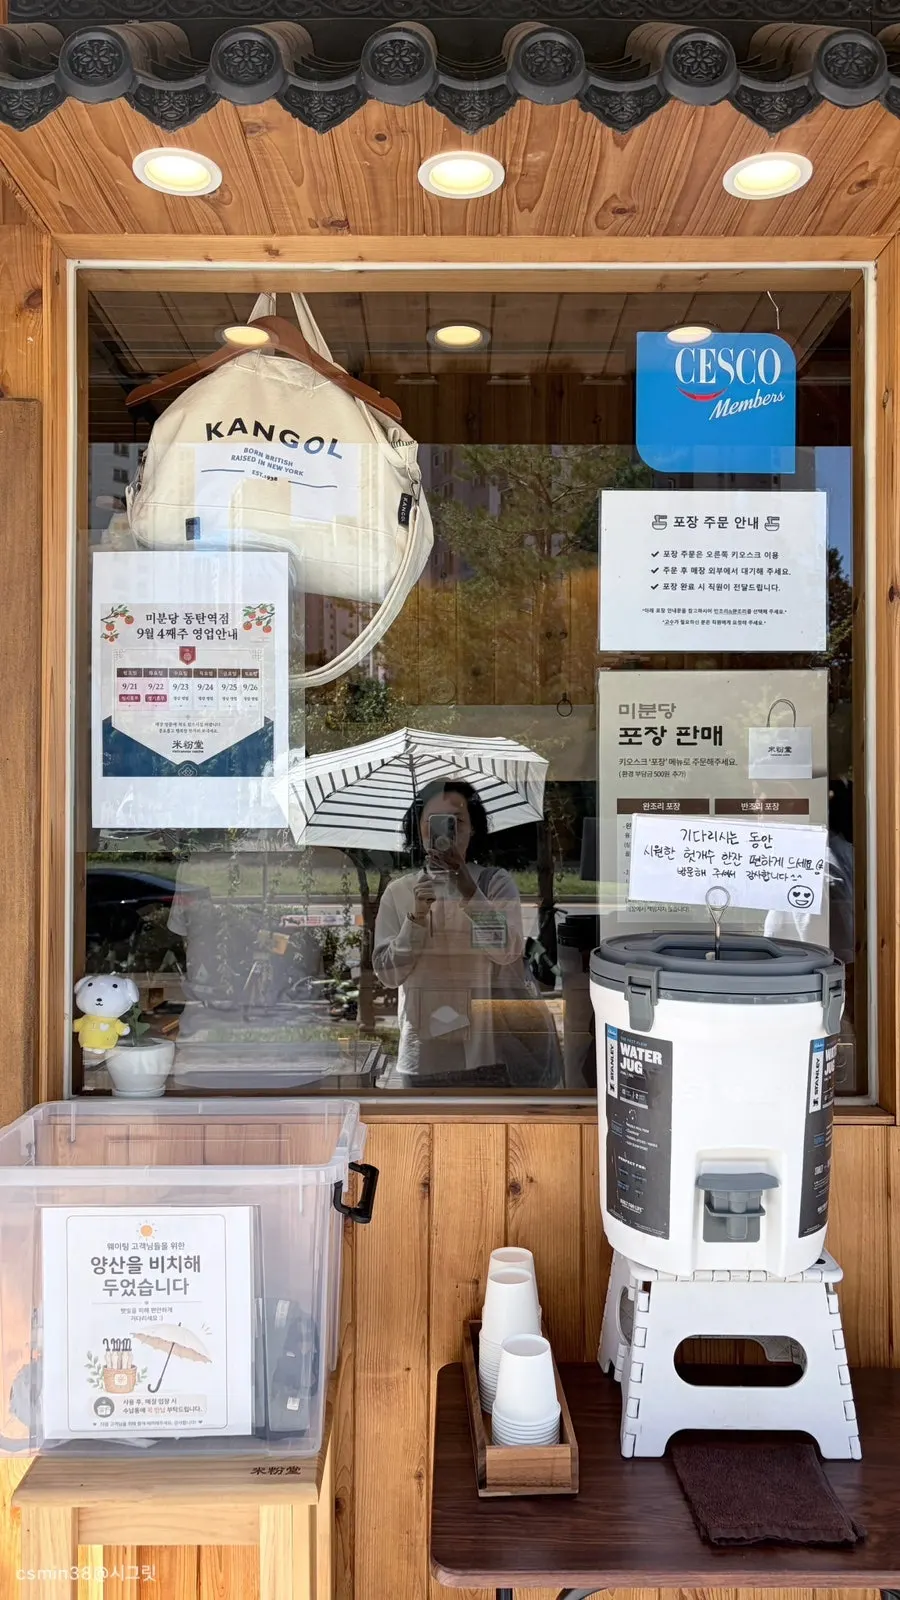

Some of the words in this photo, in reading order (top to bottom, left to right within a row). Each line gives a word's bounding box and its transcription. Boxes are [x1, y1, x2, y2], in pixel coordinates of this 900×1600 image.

[674, 347, 782, 385] CESCO
[709, 388, 785, 421] Members
[205, 417, 343, 460] KANGOL
[243, 447, 264, 458] BORN
[265, 454, 294, 467] BRITISH
[230, 455, 256, 466] RAISED
[257, 459, 266, 467] IN
[267, 462, 283, 472] NEW
[284, 467, 305, 477] YORK
[673, 516, 699, 530] 포장
[703, 516, 729, 530] 주문
[734, 516, 760, 531] 안내
[663, 550, 678, 558] 포장
[681, 550, 703, 559] 주문은
[705, 550, 728, 559] 오른쪽
[731, 551, 762, 559] 키오스크
[764, 551, 779, 559] 이용
[663, 567, 678, 575] 주문
[680, 567, 688, 575] 후
[690, 567, 705, 575] 매장
[708, 567, 738, 576] 외부에서
[741, 568, 764, 576] 대기해
[766, 568, 791, 576] 주세요.
[662, 583, 677, 591] 포장
[680, 583, 695, 591] 완료
[697, 583, 705, 591] 시
[708, 583, 731, 591] 직원이
[733, 583, 781, 592] 전달드립니다.
[145, 612, 179, 626] 미분당
[182, 612, 229, 626] 동탄역점
[136, 628, 155, 641] 9월
[157, 628, 189, 641] 4째주
[192, 628, 239, 641] 영업안내
[122, 683, 138, 691] 9/21
[148, 683, 164, 691] 9/22
[172, 683, 189, 691] 9/23
[197, 683, 214, 691] 9/24
[221, 683, 238, 691] 9/25
[242, 683, 258, 691] 9/26
[618, 703, 677, 720] 미분당
[618, 725, 667, 747] 포장
[676, 725, 723, 747] 판매
[172, 739, 204, 750] 米粉堂
[618, 757, 648, 766] 키오스크
[668, 757, 691, 767] 메뉴로
[692, 757, 738, 767] 주문해주세요.
[635, 770, 653, 778] 부담금
[653, 770, 670, 778] 500원
[671, 770, 687, 778] 추가)
[642, 802, 664, 811] 완조리
[665, 802, 681, 811] 포장
[740, 802, 763, 811] 반조리
[764, 802, 779, 811] 포장
[680, 828, 740, 845] 기다리시는
[748, 832, 774, 850] 동안
[643, 844, 676, 861] 시원한
[683, 846, 716, 865] 헛개수
[721, 851, 743, 867] 한잔
[749, 854, 785, 869] 편하게
[786, 856, 814, 871] 드세요
[676, 866, 707, 877] 방문해
[745, 869, 789, 882] 감사합니다
[619, 1041, 663, 1066] WATER
[619, 1056, 643, 1075] JUG
[106, 1242, 130, 1251] 웨이팅
[131, 1242, 168, 1251] 고객님들을
[170, 1241, 185, 1250] 위한
[90, 1255, 144, 1275] 양산을
[149, 1255, 201, 1274] 비치해
[102, 1277, 189, 1297] 두었습니다
[250, 1465, 302, 1476] 米粉堂
